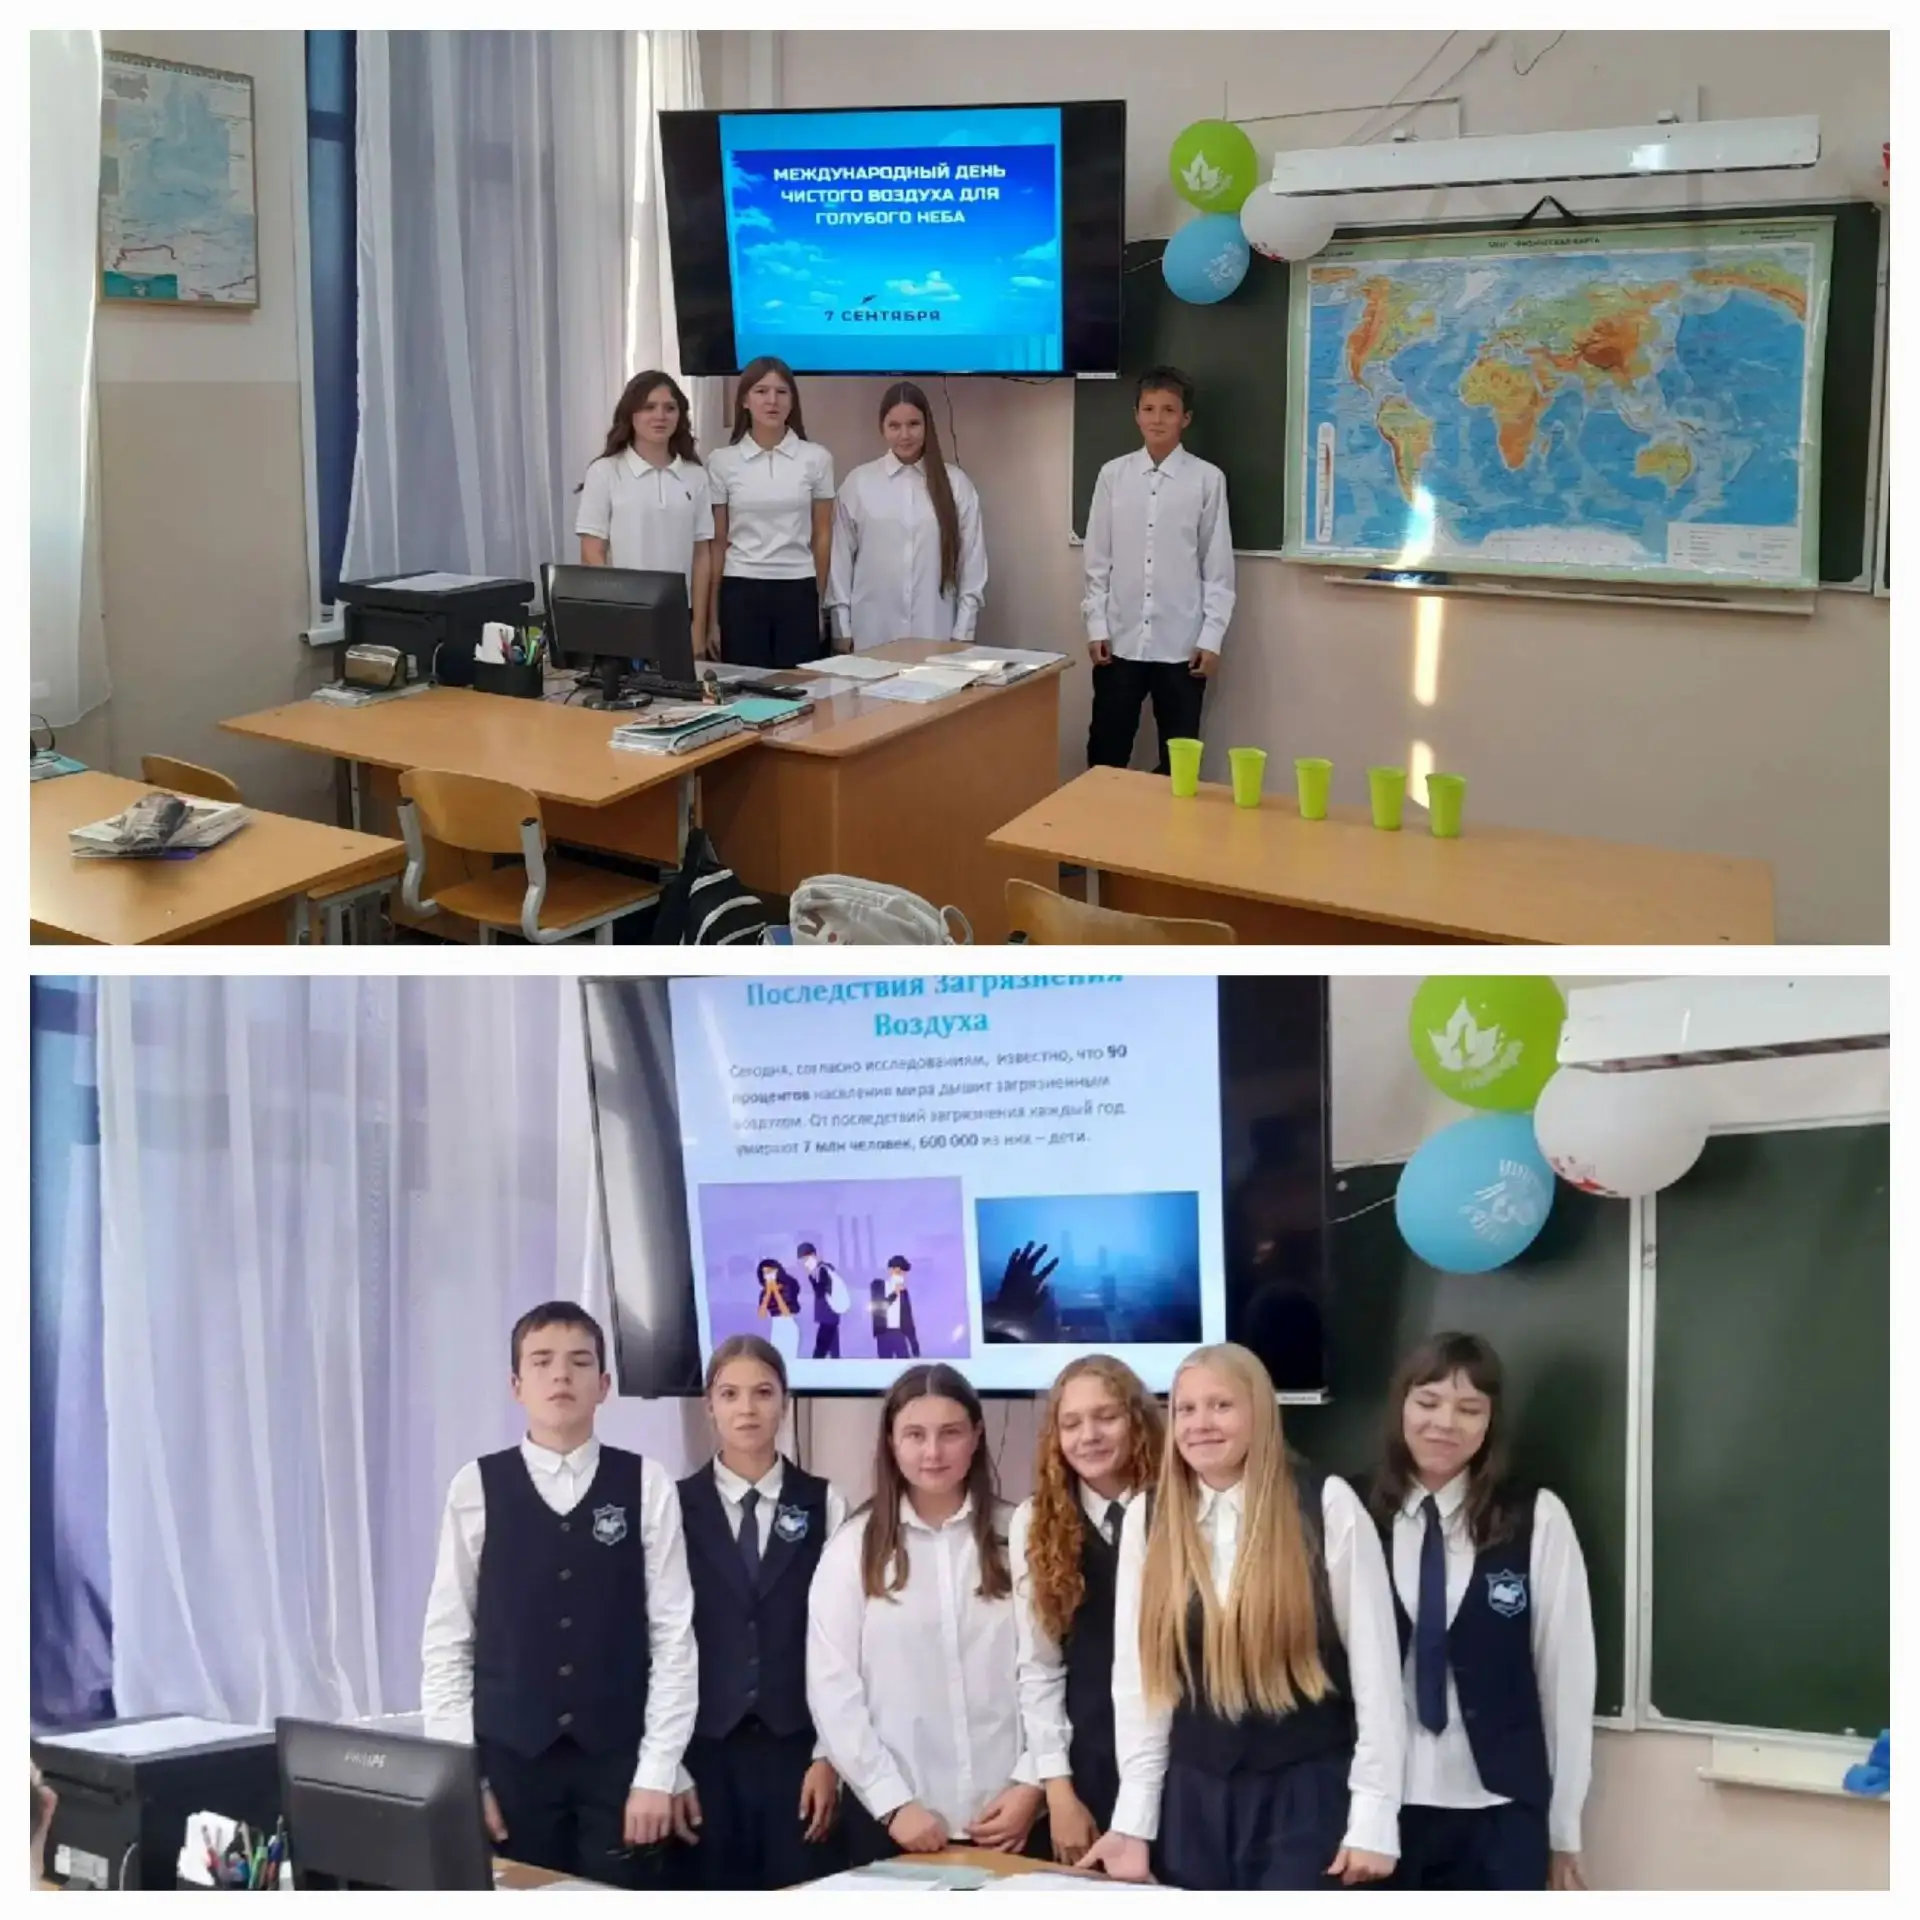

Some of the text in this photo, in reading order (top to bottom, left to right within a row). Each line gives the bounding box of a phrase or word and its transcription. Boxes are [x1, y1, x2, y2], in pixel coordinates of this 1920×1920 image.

[773, 162, 1006, 182] МЕЖДУНАРОДНЫЙ ДЕНЬ
[781, 187, 1000, 203] ЧИСТОГО ВОЗДУХА ДЛЯ
[815, 211, 966, 226] ГОЛУБОГО НЕБА
[824, 310, 941, 322] 7 СЕНТЯБРЯ
[746, 977, 925, 1006] Последствия
[874, 1012, 990, 1039] Воздуха
[797, 1060, 862, 1076] согласно
[866, 1055, 990, 1072] исследованиям,
[997, 1050, 1073, 1066] известно,
[1077, 1048, 1104, 1060] что
[1107, 1044, 1128, 1059] 90
[733, 1075, 1111, 1105] процентов населения мира дышит загрязненным
[832, 1109, 926, 1127] последствий
[930, 1105, 1025, 1123] загрязнения
[1030, 1098, 1093, 1119] каждый
[736, 1141, 799, 1158] умирают
[803, 1140, 811, 1154] 7
[816, 1141, 846, 1153] млн
[850, 1136, 916, 1152] человек,
[919, 1134, 947, 1149] 600
[950, 1133, 979, 1147] 000
